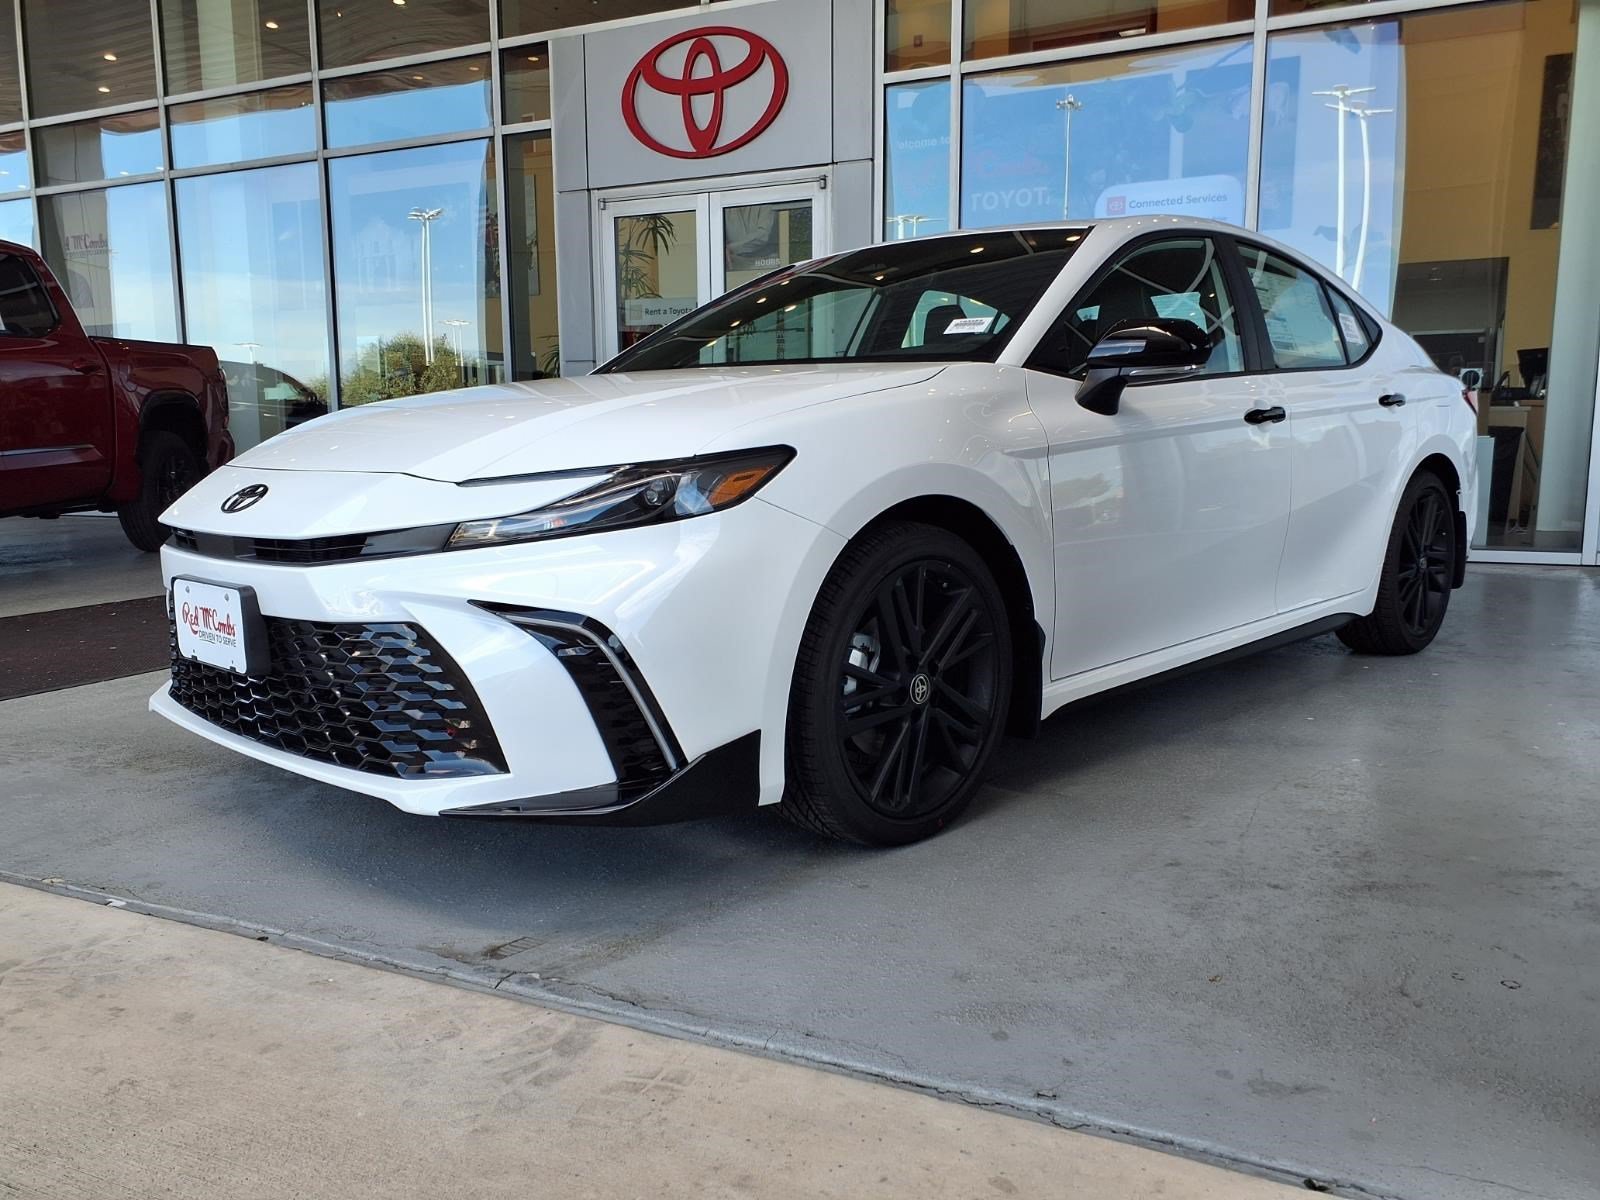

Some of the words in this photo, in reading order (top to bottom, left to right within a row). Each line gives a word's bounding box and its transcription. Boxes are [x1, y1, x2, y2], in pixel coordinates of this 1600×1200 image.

[971, 187, 1051, 211] TOYOT
[1129, 195, 1183, 209] Connected
[1186, 193, 1228, 204] Services
[645, 308, 661, 316] Rent
[182, 602, 199, 635] Red
[199, 607, 236, 637] McCombs
[199, 630, 215, 641] DRIVEN
[216, 634, 222, 643] TO
[223, 636, 236, 647] SERVE
